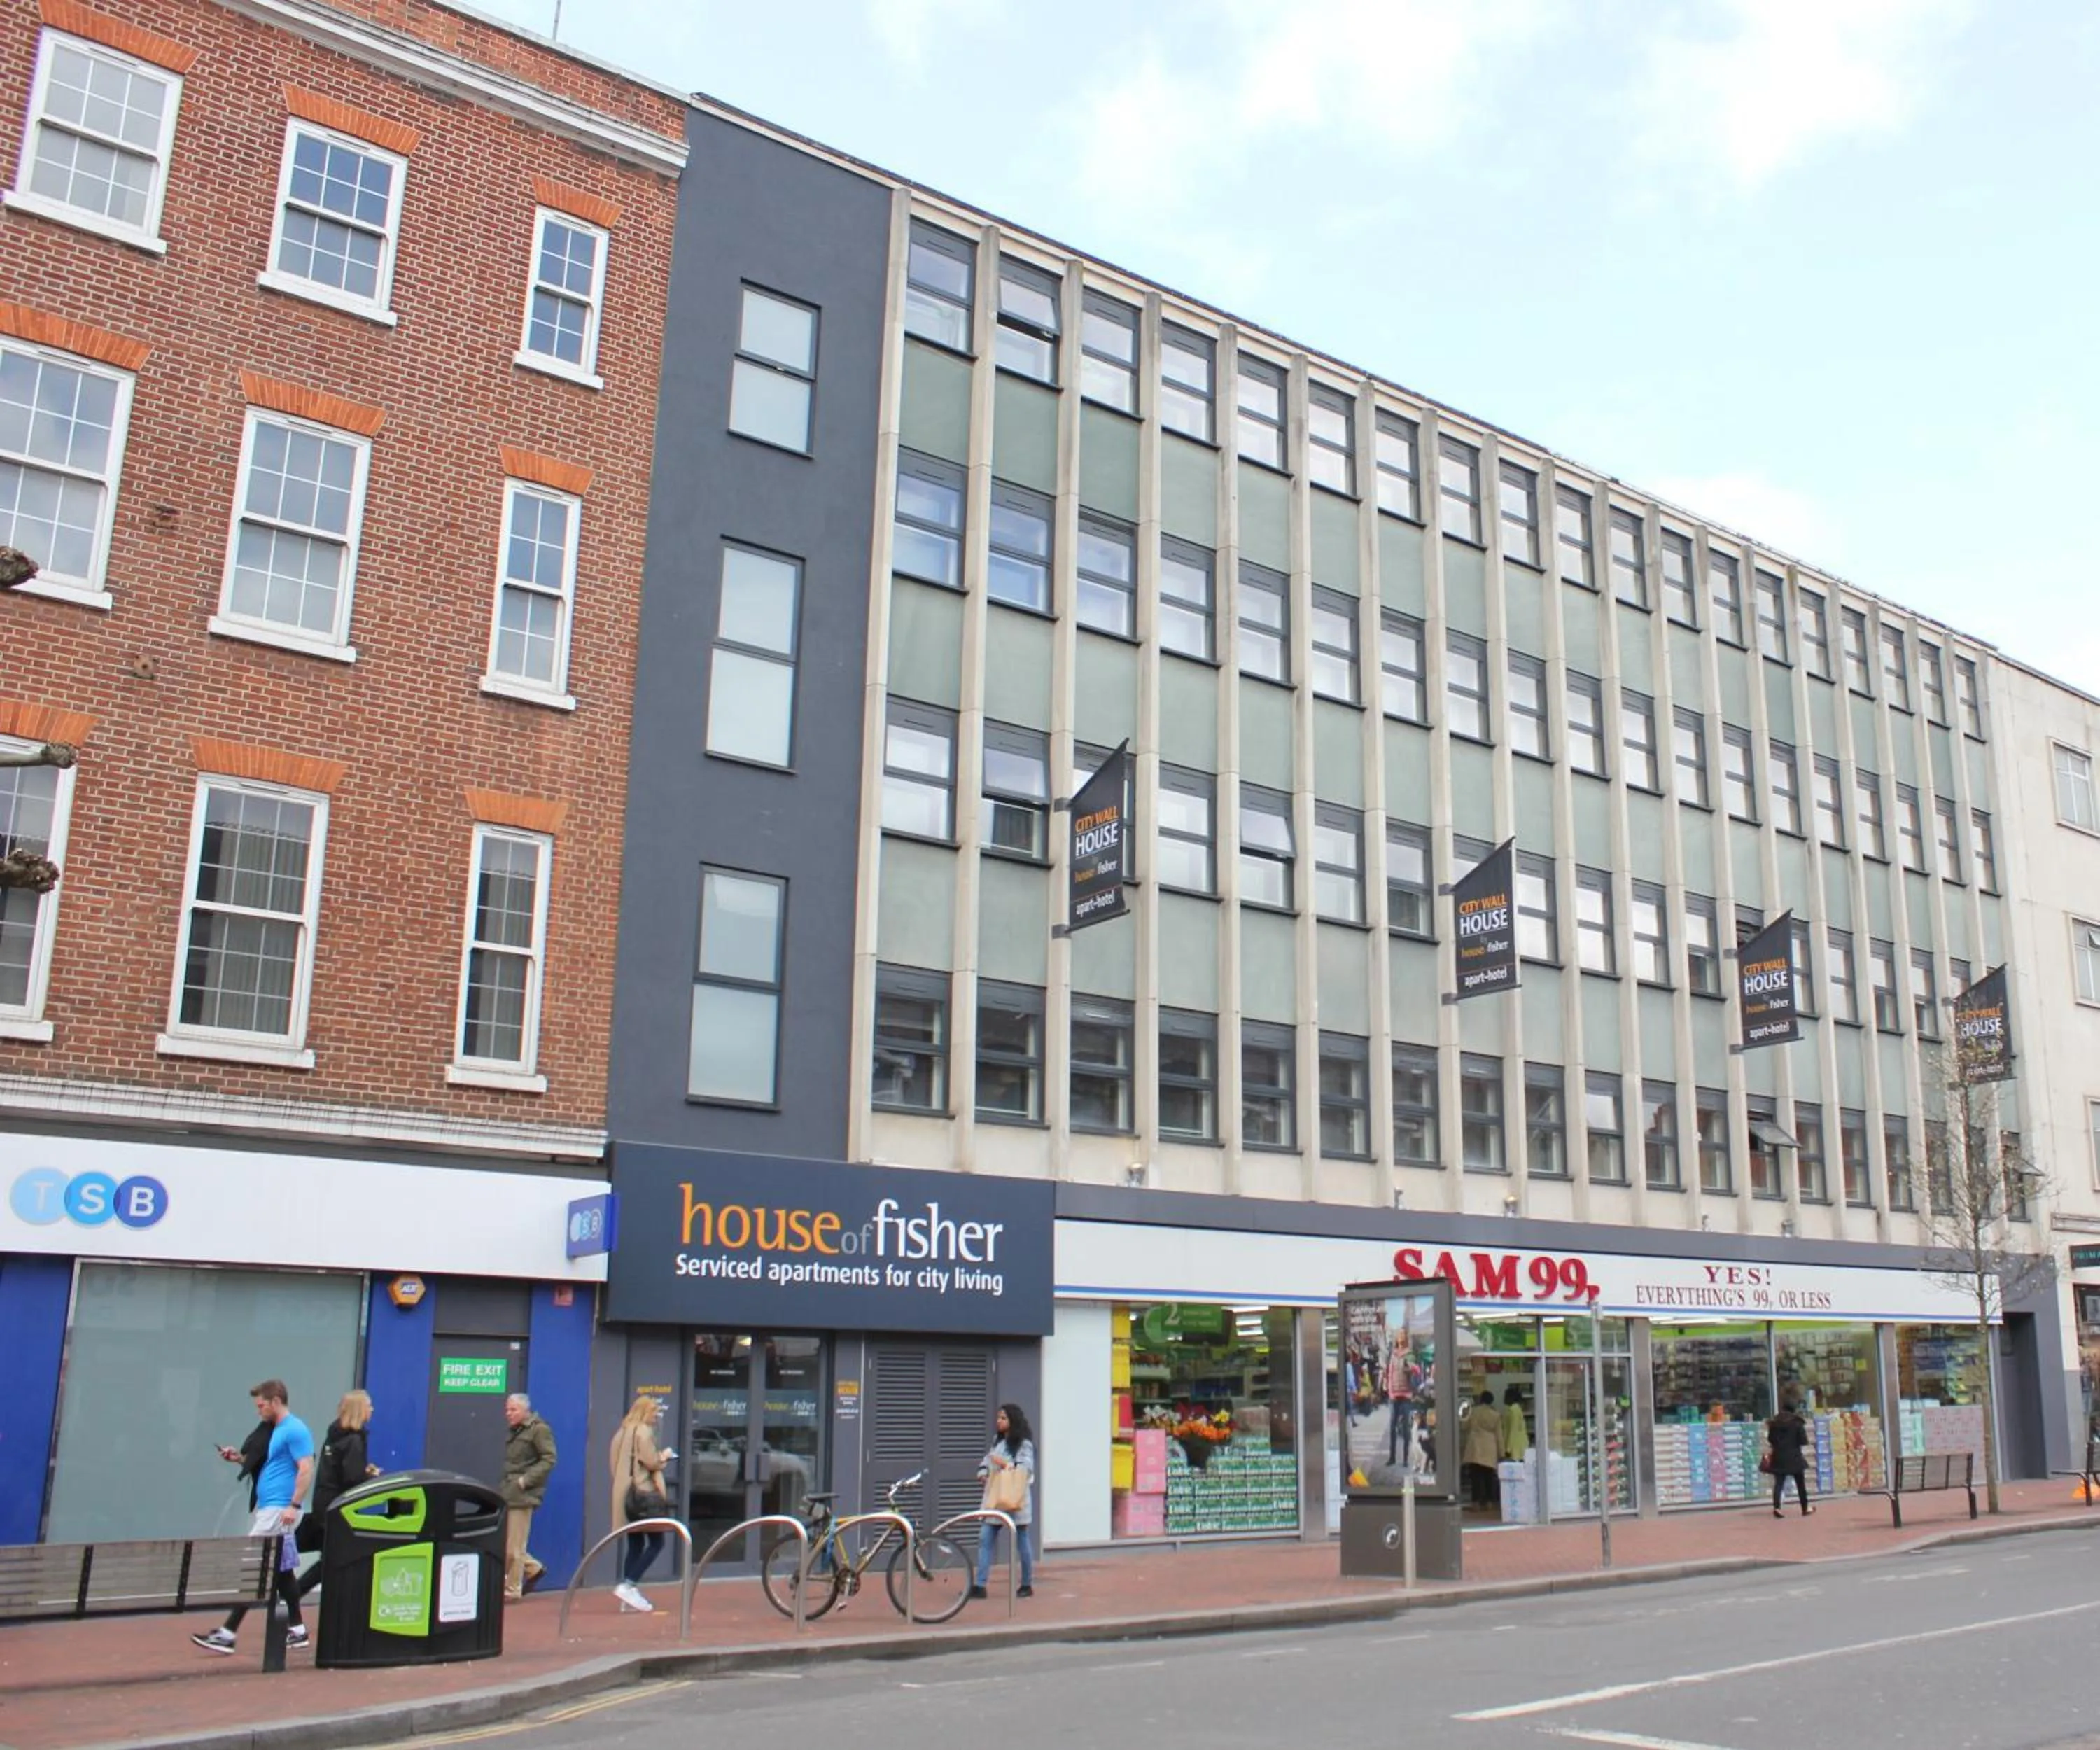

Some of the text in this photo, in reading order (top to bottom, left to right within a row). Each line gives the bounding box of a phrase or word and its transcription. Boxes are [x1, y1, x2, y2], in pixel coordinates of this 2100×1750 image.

[1075, 806, 1118, 832] CITY WALL
[1075, 822, 1119, 856] HOUSE
[1097, 860, 1118, 875] fisher
[1076, 890, 1115, 917] apart-hotel
[1460, 894, 1507, 914] CITY WALL
[1460, 909, 1508, 935] HOUSE
[1464, 967, 1507, 988] apart-hotel
[1744, 958, 1788, 975] CITY WALL
[1744, 972, 1788, 995] HOUSE
[1770, 998, 1789, 1009] fisher
[1750, 1022, 1790, 1040] apart-hotel
[1960, 1018, 2003, 1040] HOUSE
[31, 1179, 156, 1217] TSB
[678, 1182, 1004, 1263] house of fisher
[676, 1254, 1004, 1296] Serviced apartments for city living
[1393, 1248, 1522, 1299] SAM
[1704, 1266, 1771, 1286] YES!
[1636, 1284, 1745, 1307] EVERYTHING'S
[1779, 1290, 1798, 1308] OR
[1802, 1291, 1832, 1309] LESS
[443, 1364, 503, 1376] FIRE EXIT
[444, 1378, 500, 1387] KEEP CLEAR
